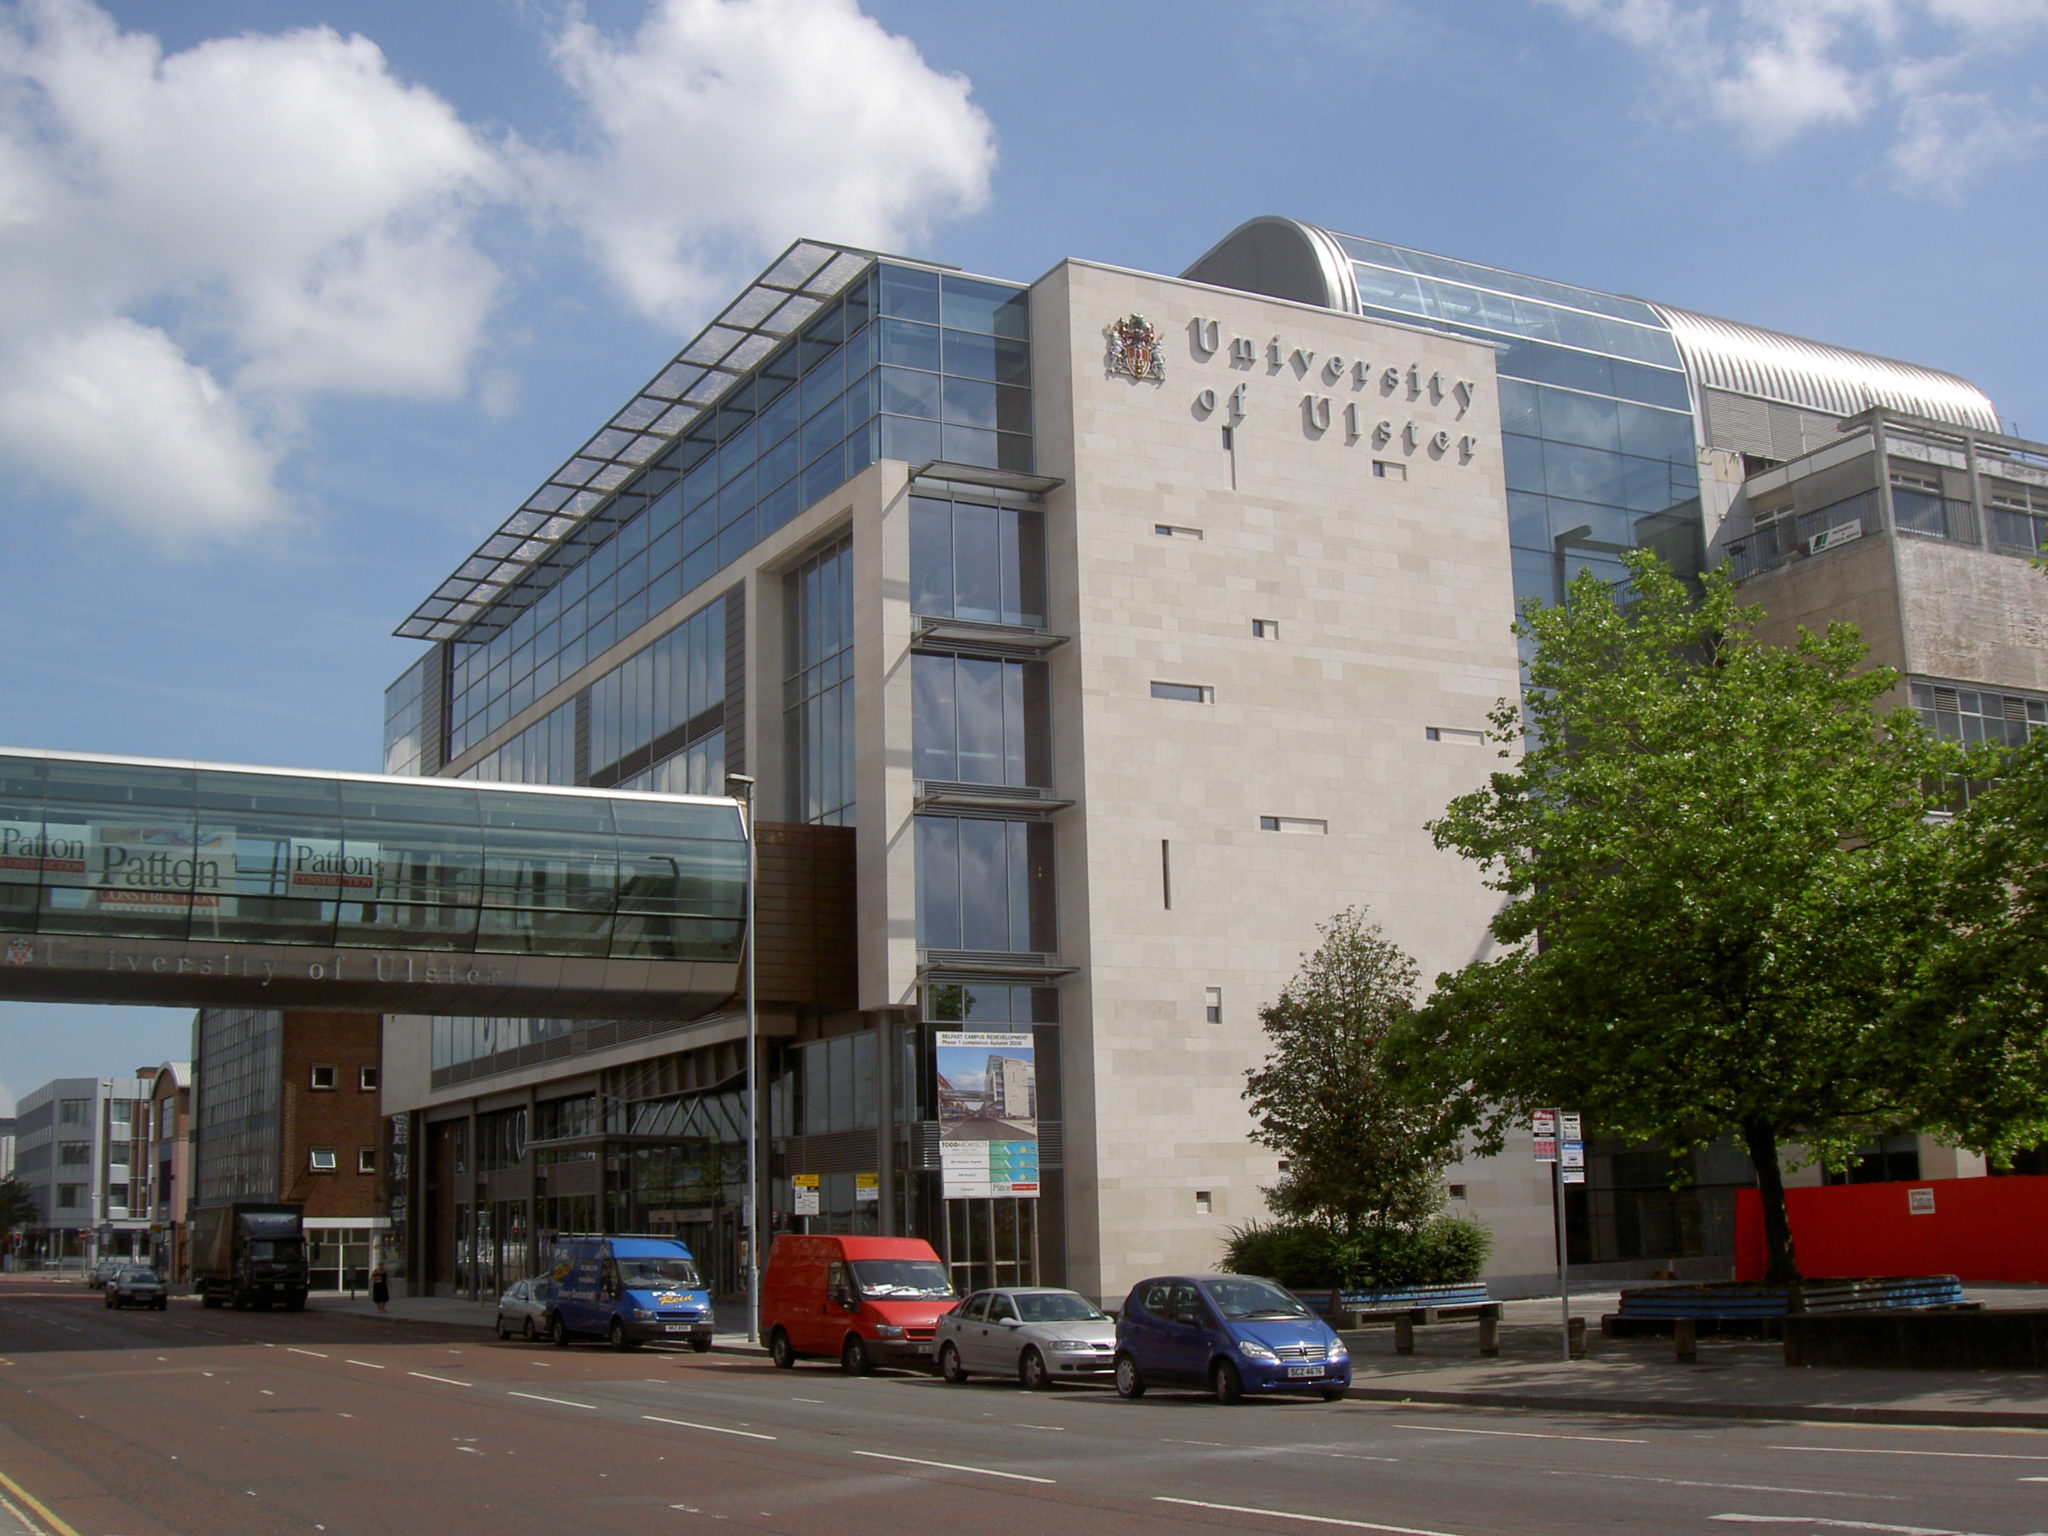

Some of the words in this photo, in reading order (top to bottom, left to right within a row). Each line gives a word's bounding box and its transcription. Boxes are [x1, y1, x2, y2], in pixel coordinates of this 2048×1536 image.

[1193, 316, 1475, 413] University
[1199, 382, 1248, 417] of
[1303, 394, 1478, 456] Ulster
[2, 827, 85, 859] Patton
[98, 845, 220, 888] Patton
[295, 845, 373, 875] Patton
[100, 888, 217, 906] CONSTRUCTON
[308, 953, 346, 980] of
